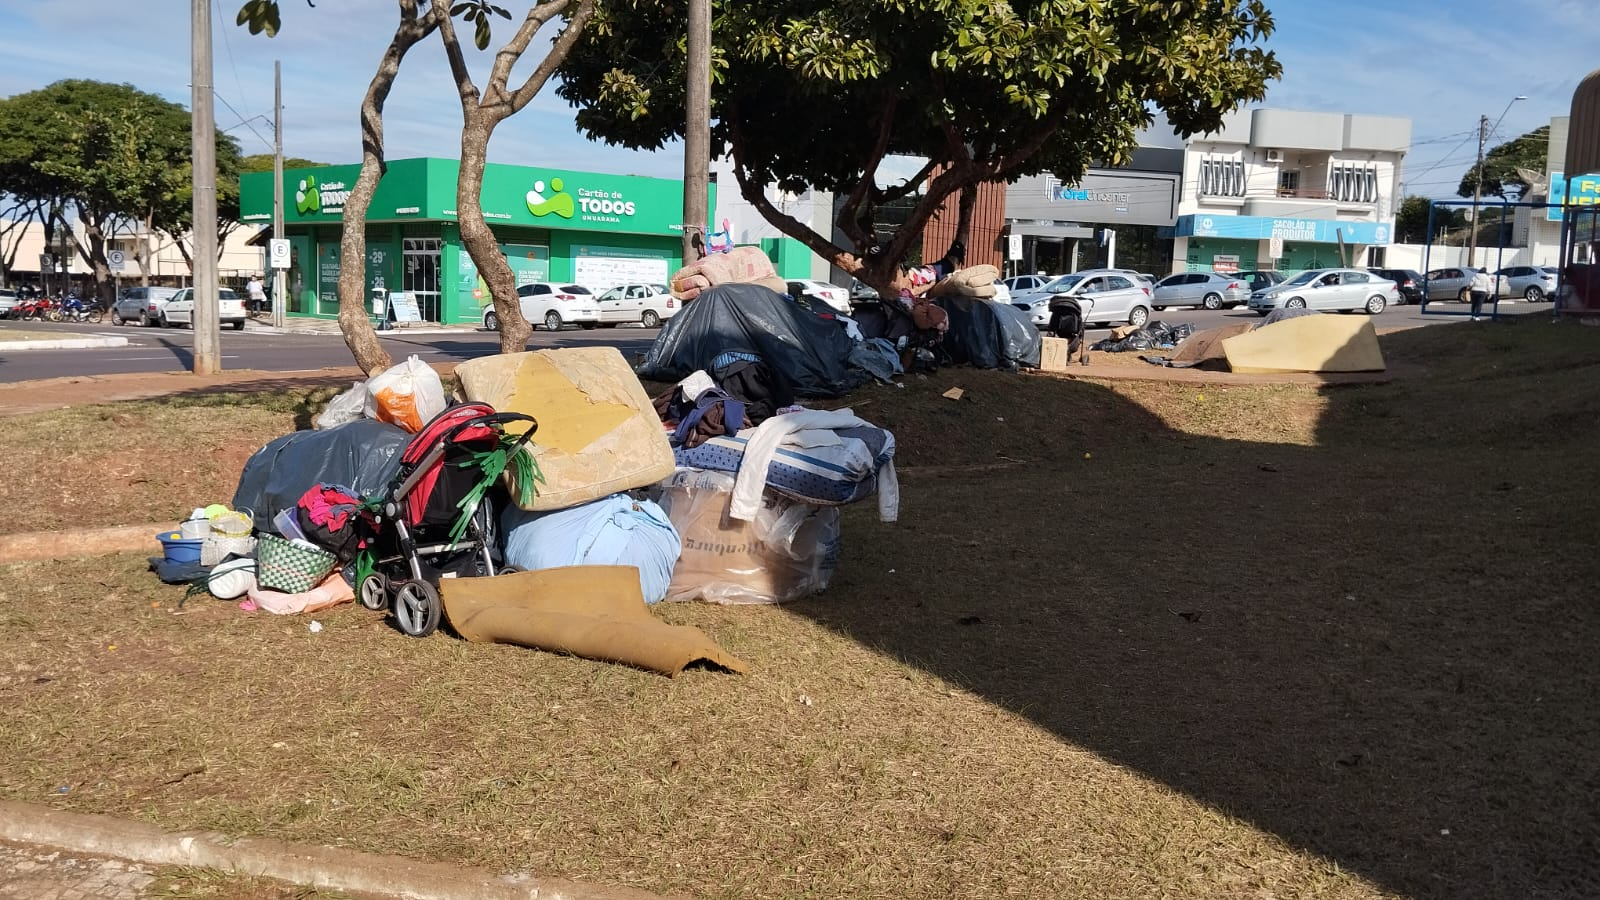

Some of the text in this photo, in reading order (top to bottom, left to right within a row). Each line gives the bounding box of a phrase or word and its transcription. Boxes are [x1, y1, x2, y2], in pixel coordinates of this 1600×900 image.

[578, 187, 623, 199] Cartão de
[578, 198, 636, 216] TODOS
[1271, 228, 1316, 240] PRODUTOR
[277, 245, 284, 255] E
